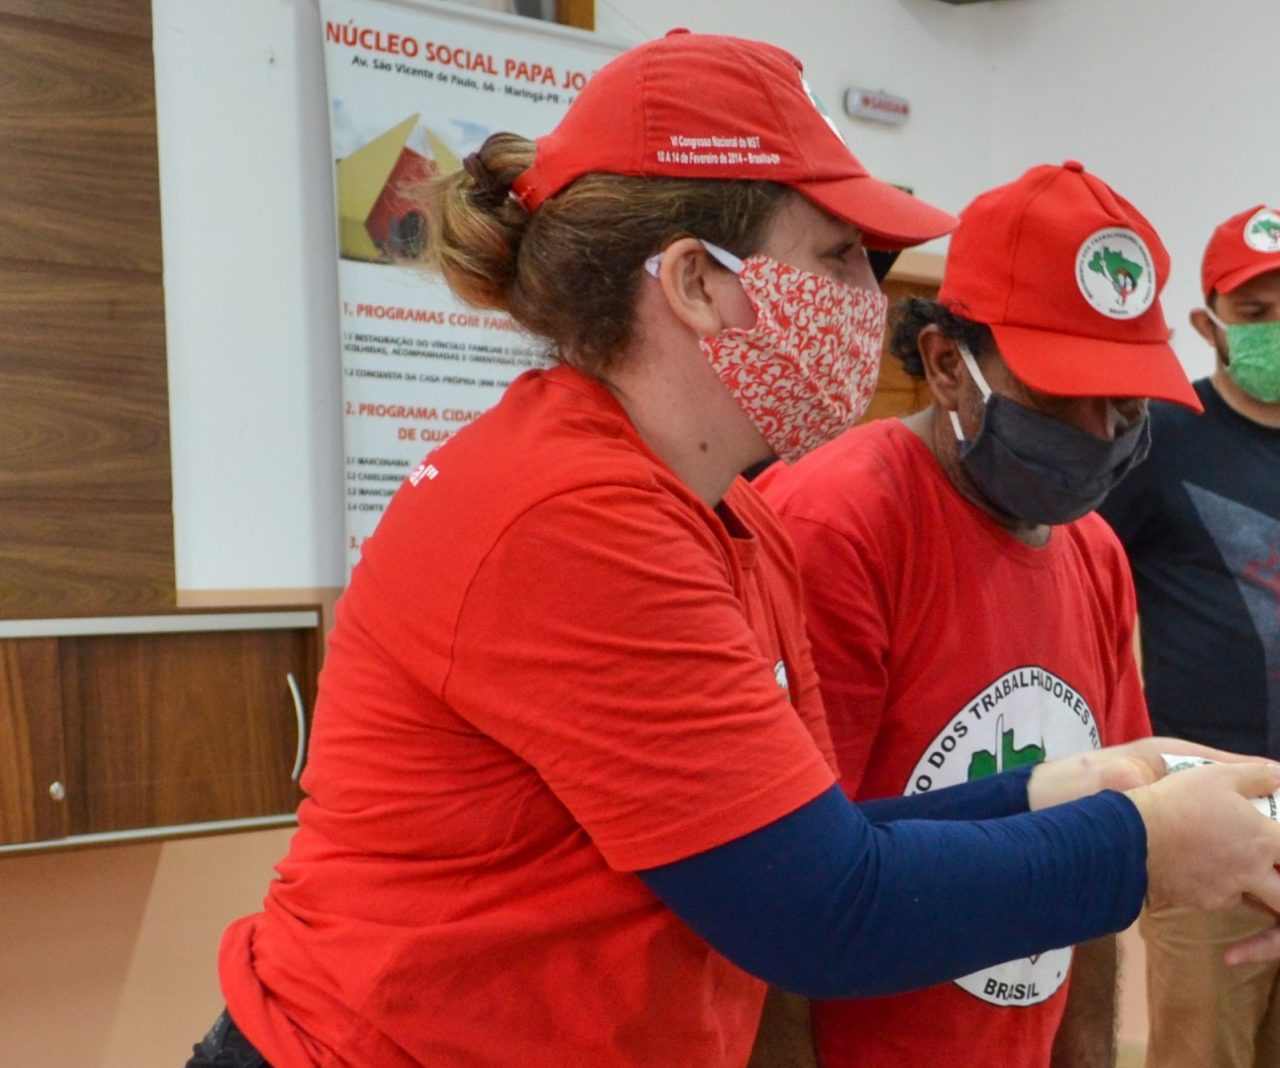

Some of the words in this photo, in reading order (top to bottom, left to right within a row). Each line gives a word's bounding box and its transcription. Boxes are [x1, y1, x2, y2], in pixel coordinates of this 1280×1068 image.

[325, 18, 419, 58] NÚCLEO
[424, 41, 498, 76] SOCIAL
[504, 58, 557, 87] PAPA
[351, 55, 369, 68] Av.
[372, 58, 392, 72] São
[395, 63, 434, 80] Vicente
[436, 71, 449, 82] de
[451, 75, 480, 92] Paulo,
[356, 303, 445, 325] PROGRAMAS
[448, 312, 480, 328] COM
[358, 402, 438, 420] PROGRAMA
[397, 426, 417, 440] DE
[927, 720, 969, 770] DOS
[968, 669, 1090, 726] TRABALHADORES
[983, 977, 1040, 1001] BRASIL
